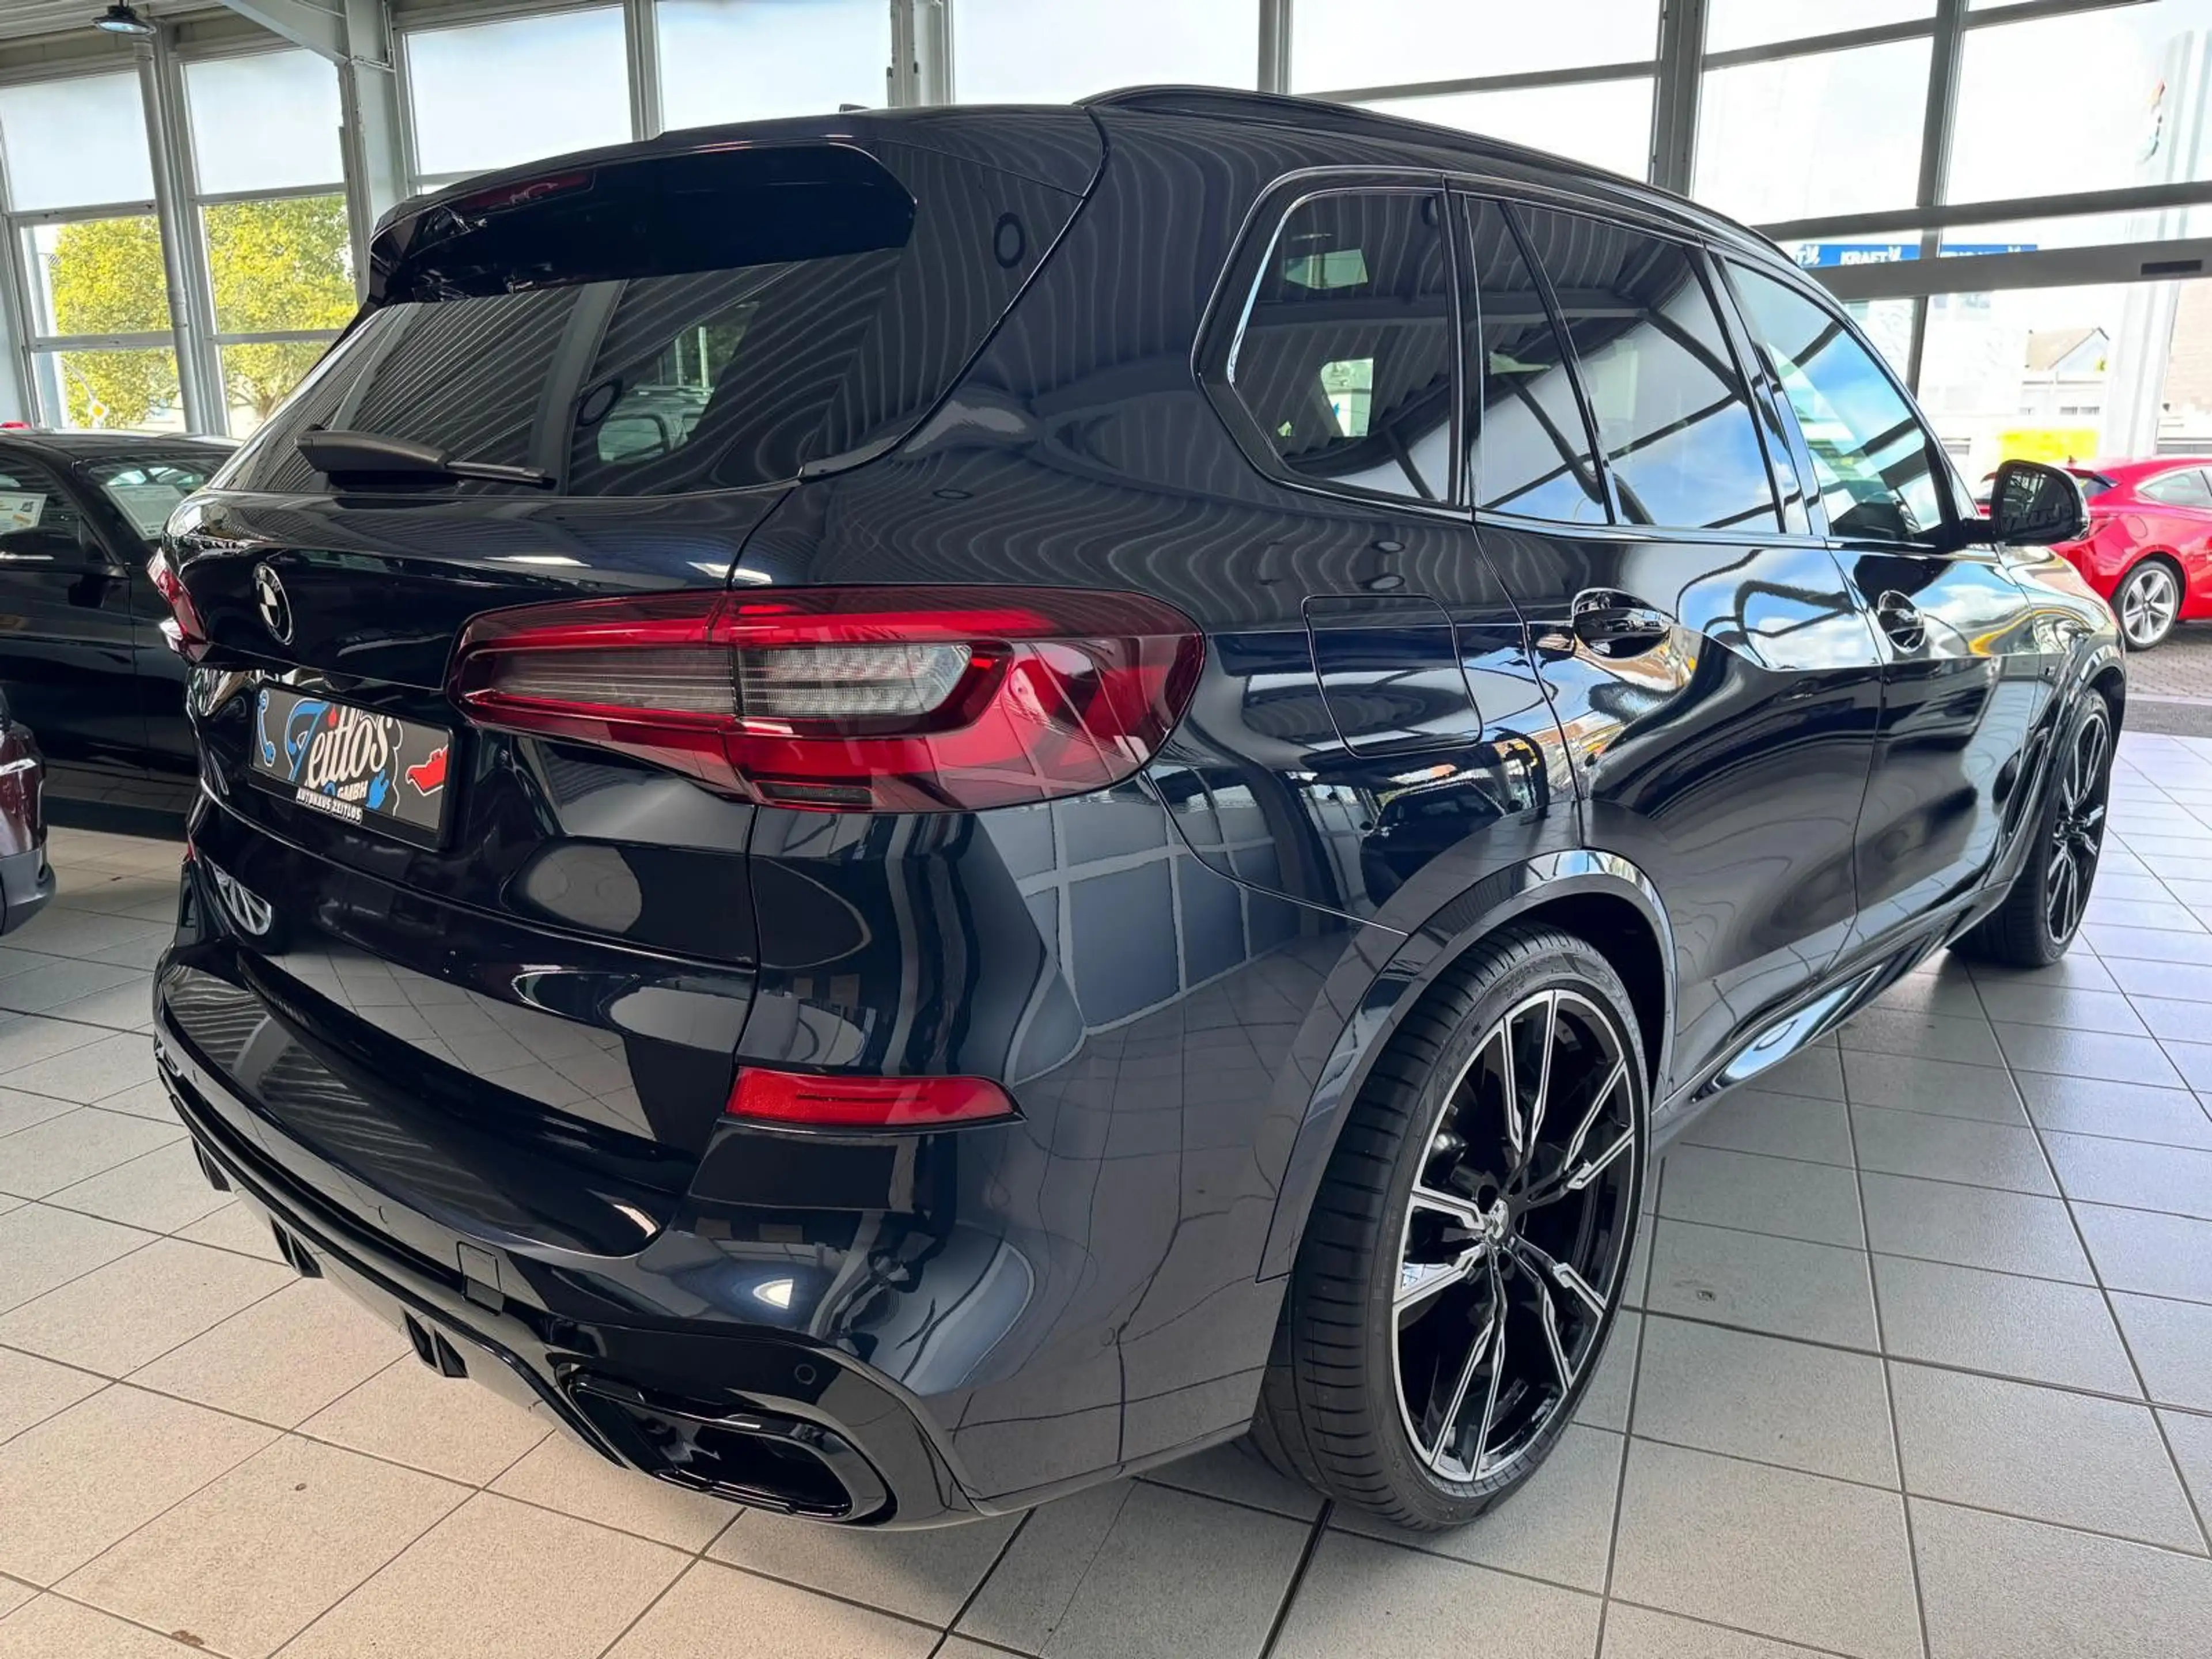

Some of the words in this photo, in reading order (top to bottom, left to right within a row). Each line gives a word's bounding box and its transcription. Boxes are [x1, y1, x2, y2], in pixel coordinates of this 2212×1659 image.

[1840, 250, 1888, 265] KRAFT
[296, 787, 332, 810] AUTOHAUS
[332, 798, 363, 823] ZEITLOS
